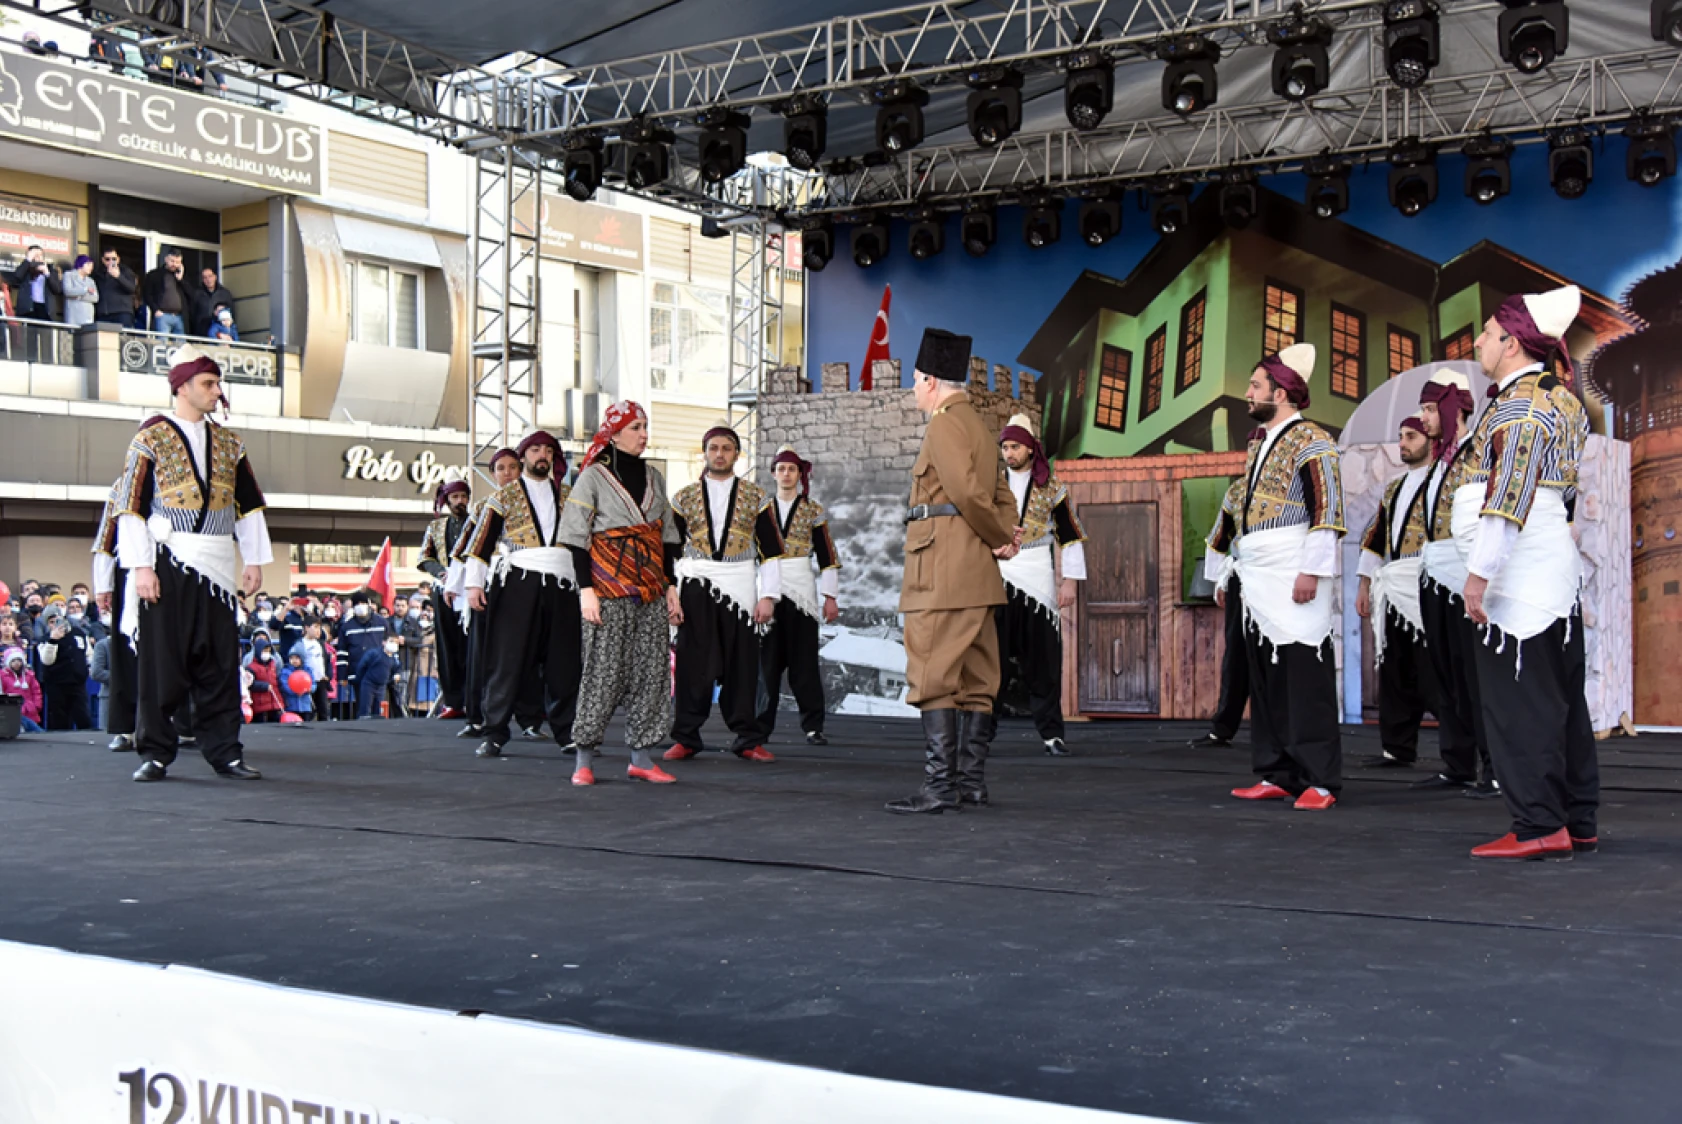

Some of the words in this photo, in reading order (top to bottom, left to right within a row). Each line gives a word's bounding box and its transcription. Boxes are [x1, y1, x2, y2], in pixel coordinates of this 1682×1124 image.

[35, 70, 176, 136] ESTE
[195, 107, 314, 163] CLUB
[118, 133, 187, 160] GÜZELLİK
[189, 147, 203, 163] &
[205, 150, 264, 176] SAĞLIKLI
[265, 163, 312, 186] YAŞAM
